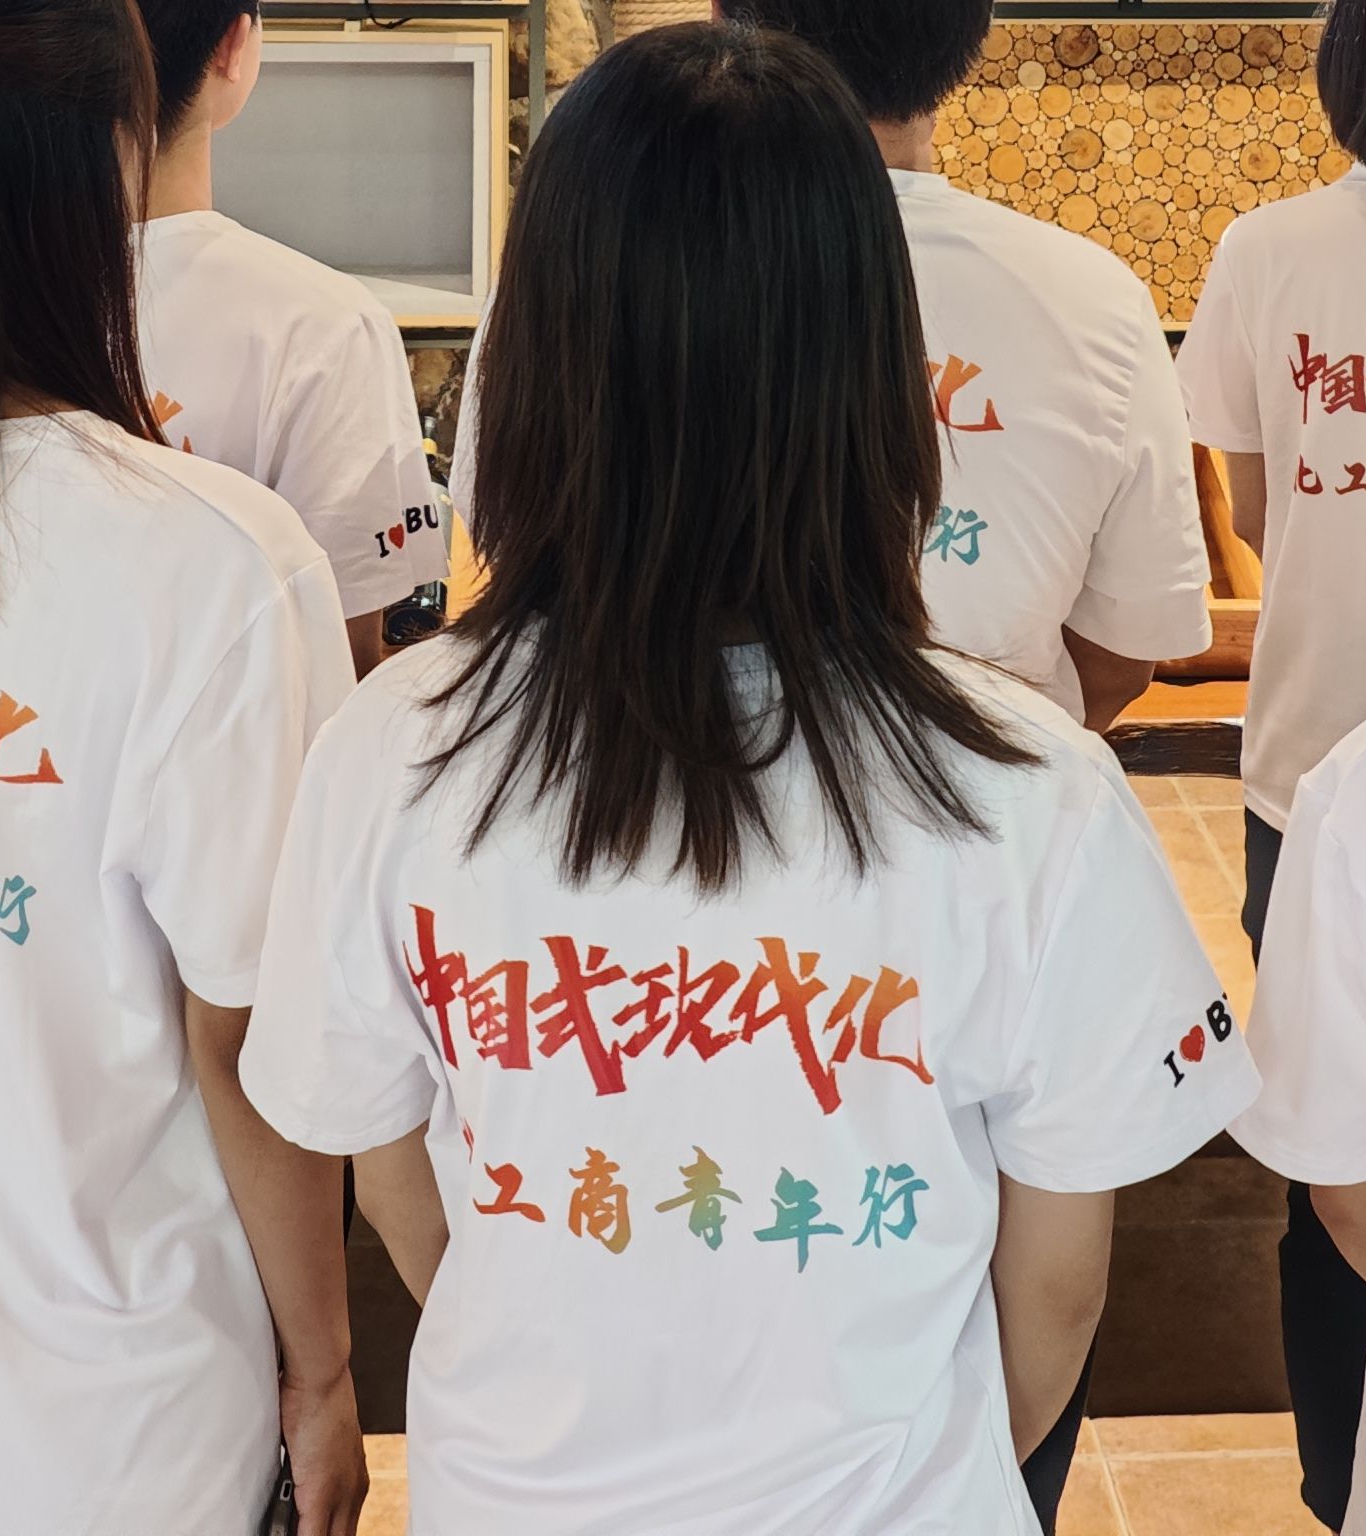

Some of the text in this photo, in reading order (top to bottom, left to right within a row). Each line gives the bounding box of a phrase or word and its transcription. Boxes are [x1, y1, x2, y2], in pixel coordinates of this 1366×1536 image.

[403, 903, 935, 1114] 中国式现代化
[1163, 1050, 1185, 1088] I
[461, 1116, 931, 1274] 工商青年行
